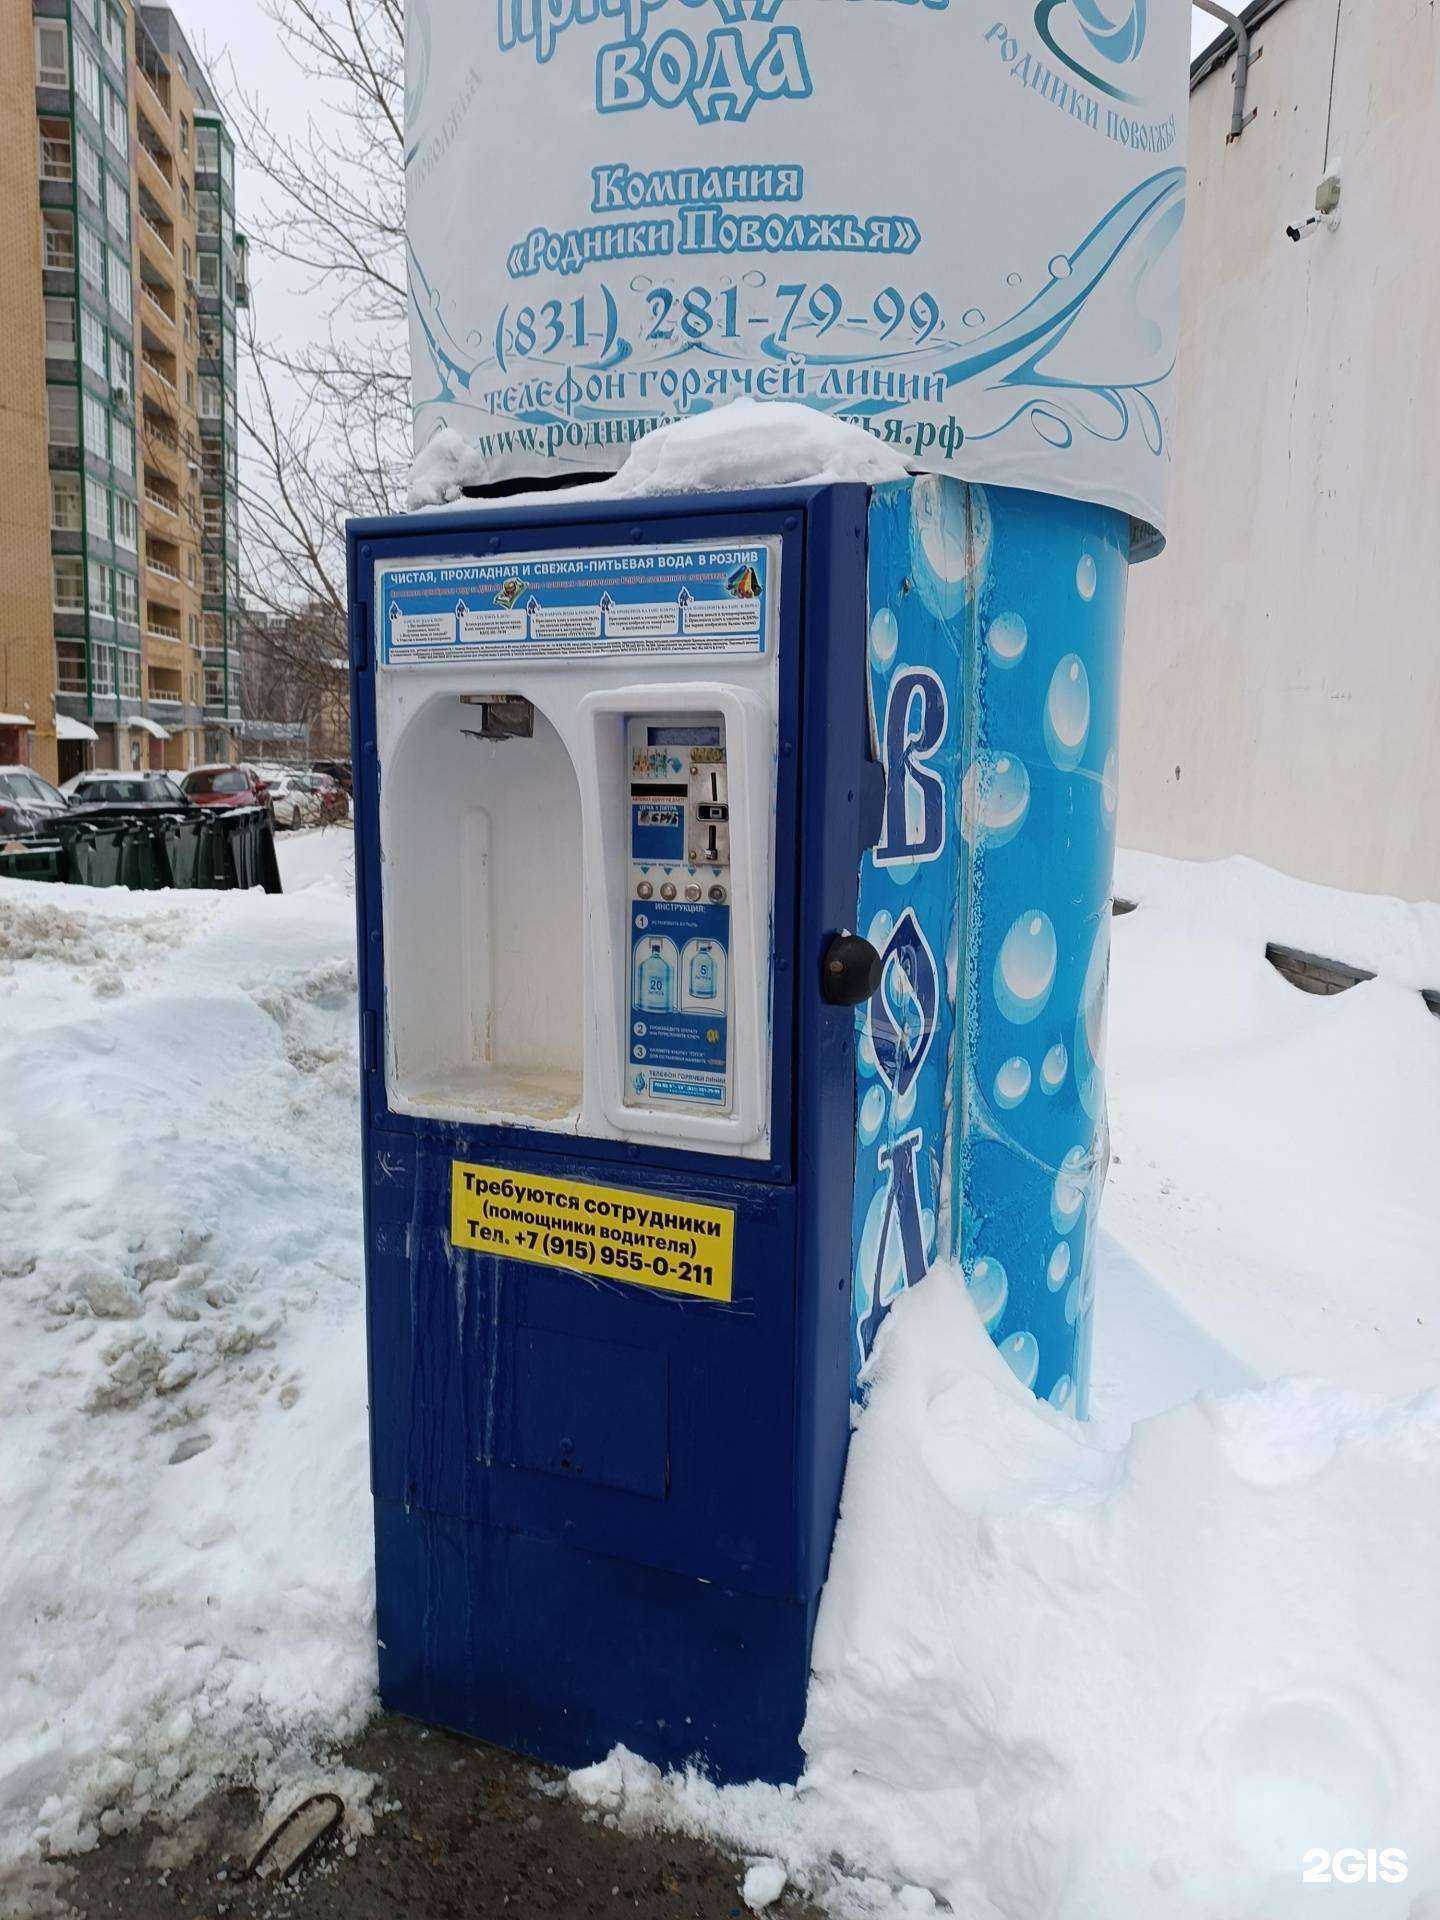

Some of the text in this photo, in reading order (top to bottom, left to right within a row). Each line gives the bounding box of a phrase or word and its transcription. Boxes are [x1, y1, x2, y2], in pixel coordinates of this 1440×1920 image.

[592, 164, 802, 211] Компания
[506, 204, 921, 278] «Родники Поволжья»
[494, 282, 941, 374] (831) 281-79-99
[391, 571, 437, 585] ЧИСТАЯ,
[440, 565, 519, 582] ПРОХЛАДНАЯ
[522, 565, 531, 576] И
[658, 555, 693, 569] ВОДА
[699, 554, 706, 565] В
[709, 551, 759, 565] РОЗЛИВ
[650, 979, 663, 991] 20
[701, 965, 707, 975] 5
[637, 1023, 643, 1034] 2
[637, 1046, 643, 1057] 3
[463, 1171, 722, 1237] Требуются сотрудники
[482, 1199, 697, 1258] (помощники водителя)
[467, 1219, 713, 1286] Тел. +7 (915) 955-0-211
